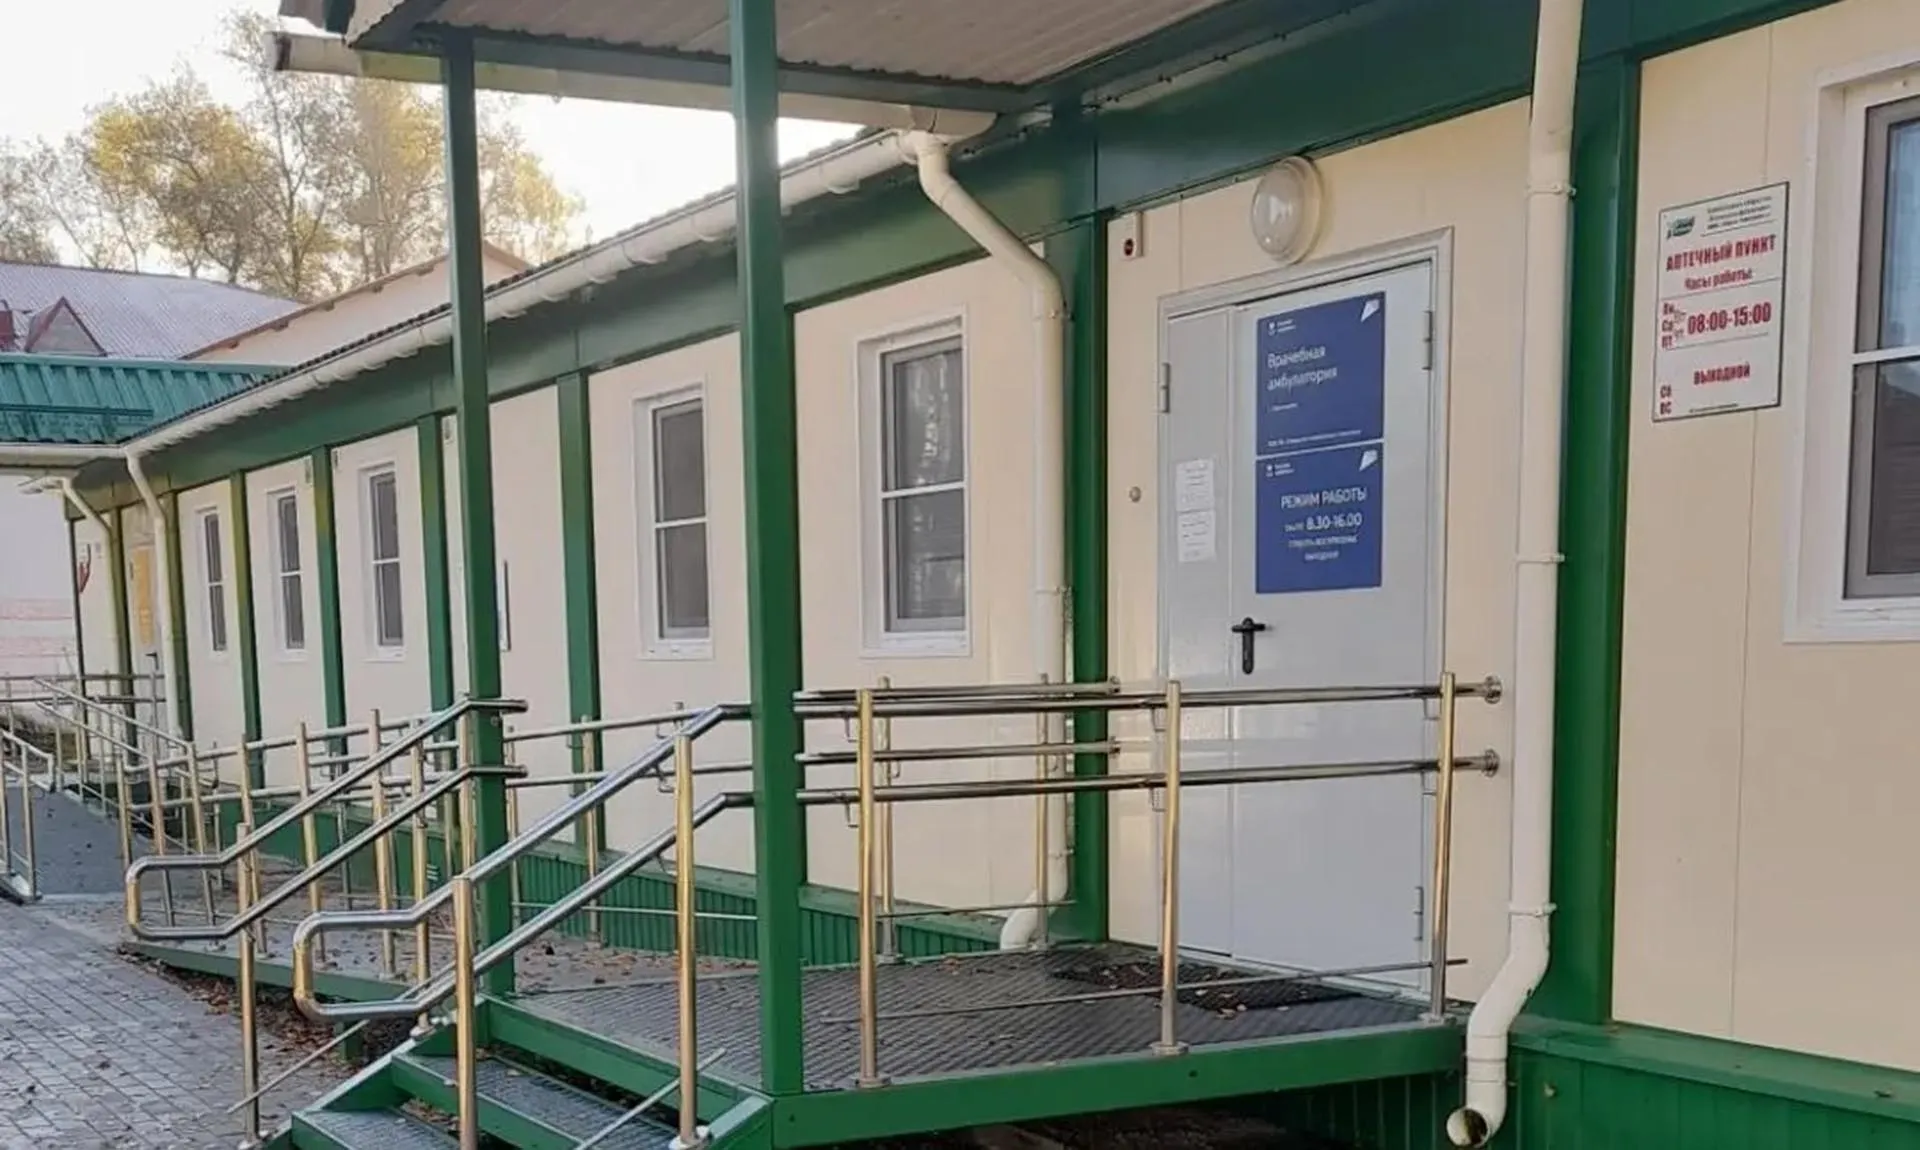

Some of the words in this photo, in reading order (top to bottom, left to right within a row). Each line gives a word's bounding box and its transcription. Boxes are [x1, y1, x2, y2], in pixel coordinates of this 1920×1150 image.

[1666, 241, 1733, 271] АПТЕЧНЫЙ
[1735, 234, 1776, 257] ПУНКТ
[1687, 302, 1771, 335] 08:00-15:00
